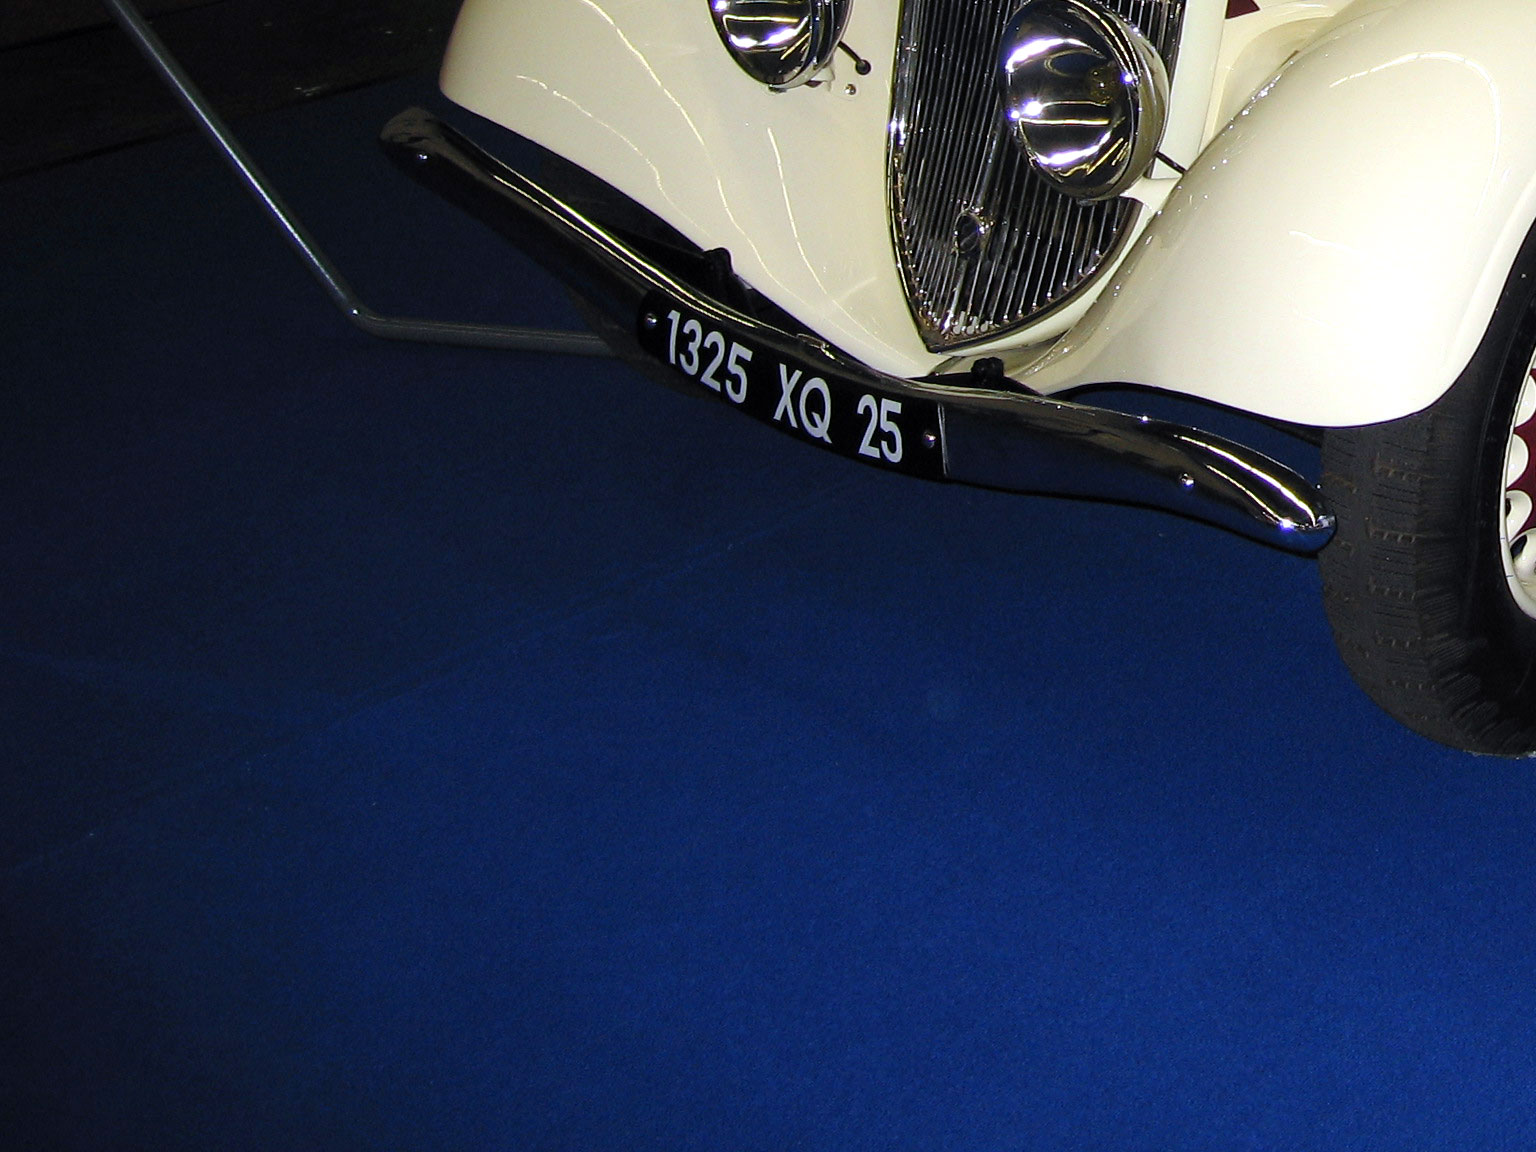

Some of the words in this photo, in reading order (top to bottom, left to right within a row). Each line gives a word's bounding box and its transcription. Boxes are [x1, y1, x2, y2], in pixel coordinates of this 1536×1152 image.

[665, 309, 754, 404] 1325
[773, 362, 833, 445] XQ
[857, 393, 904, 464] 25
